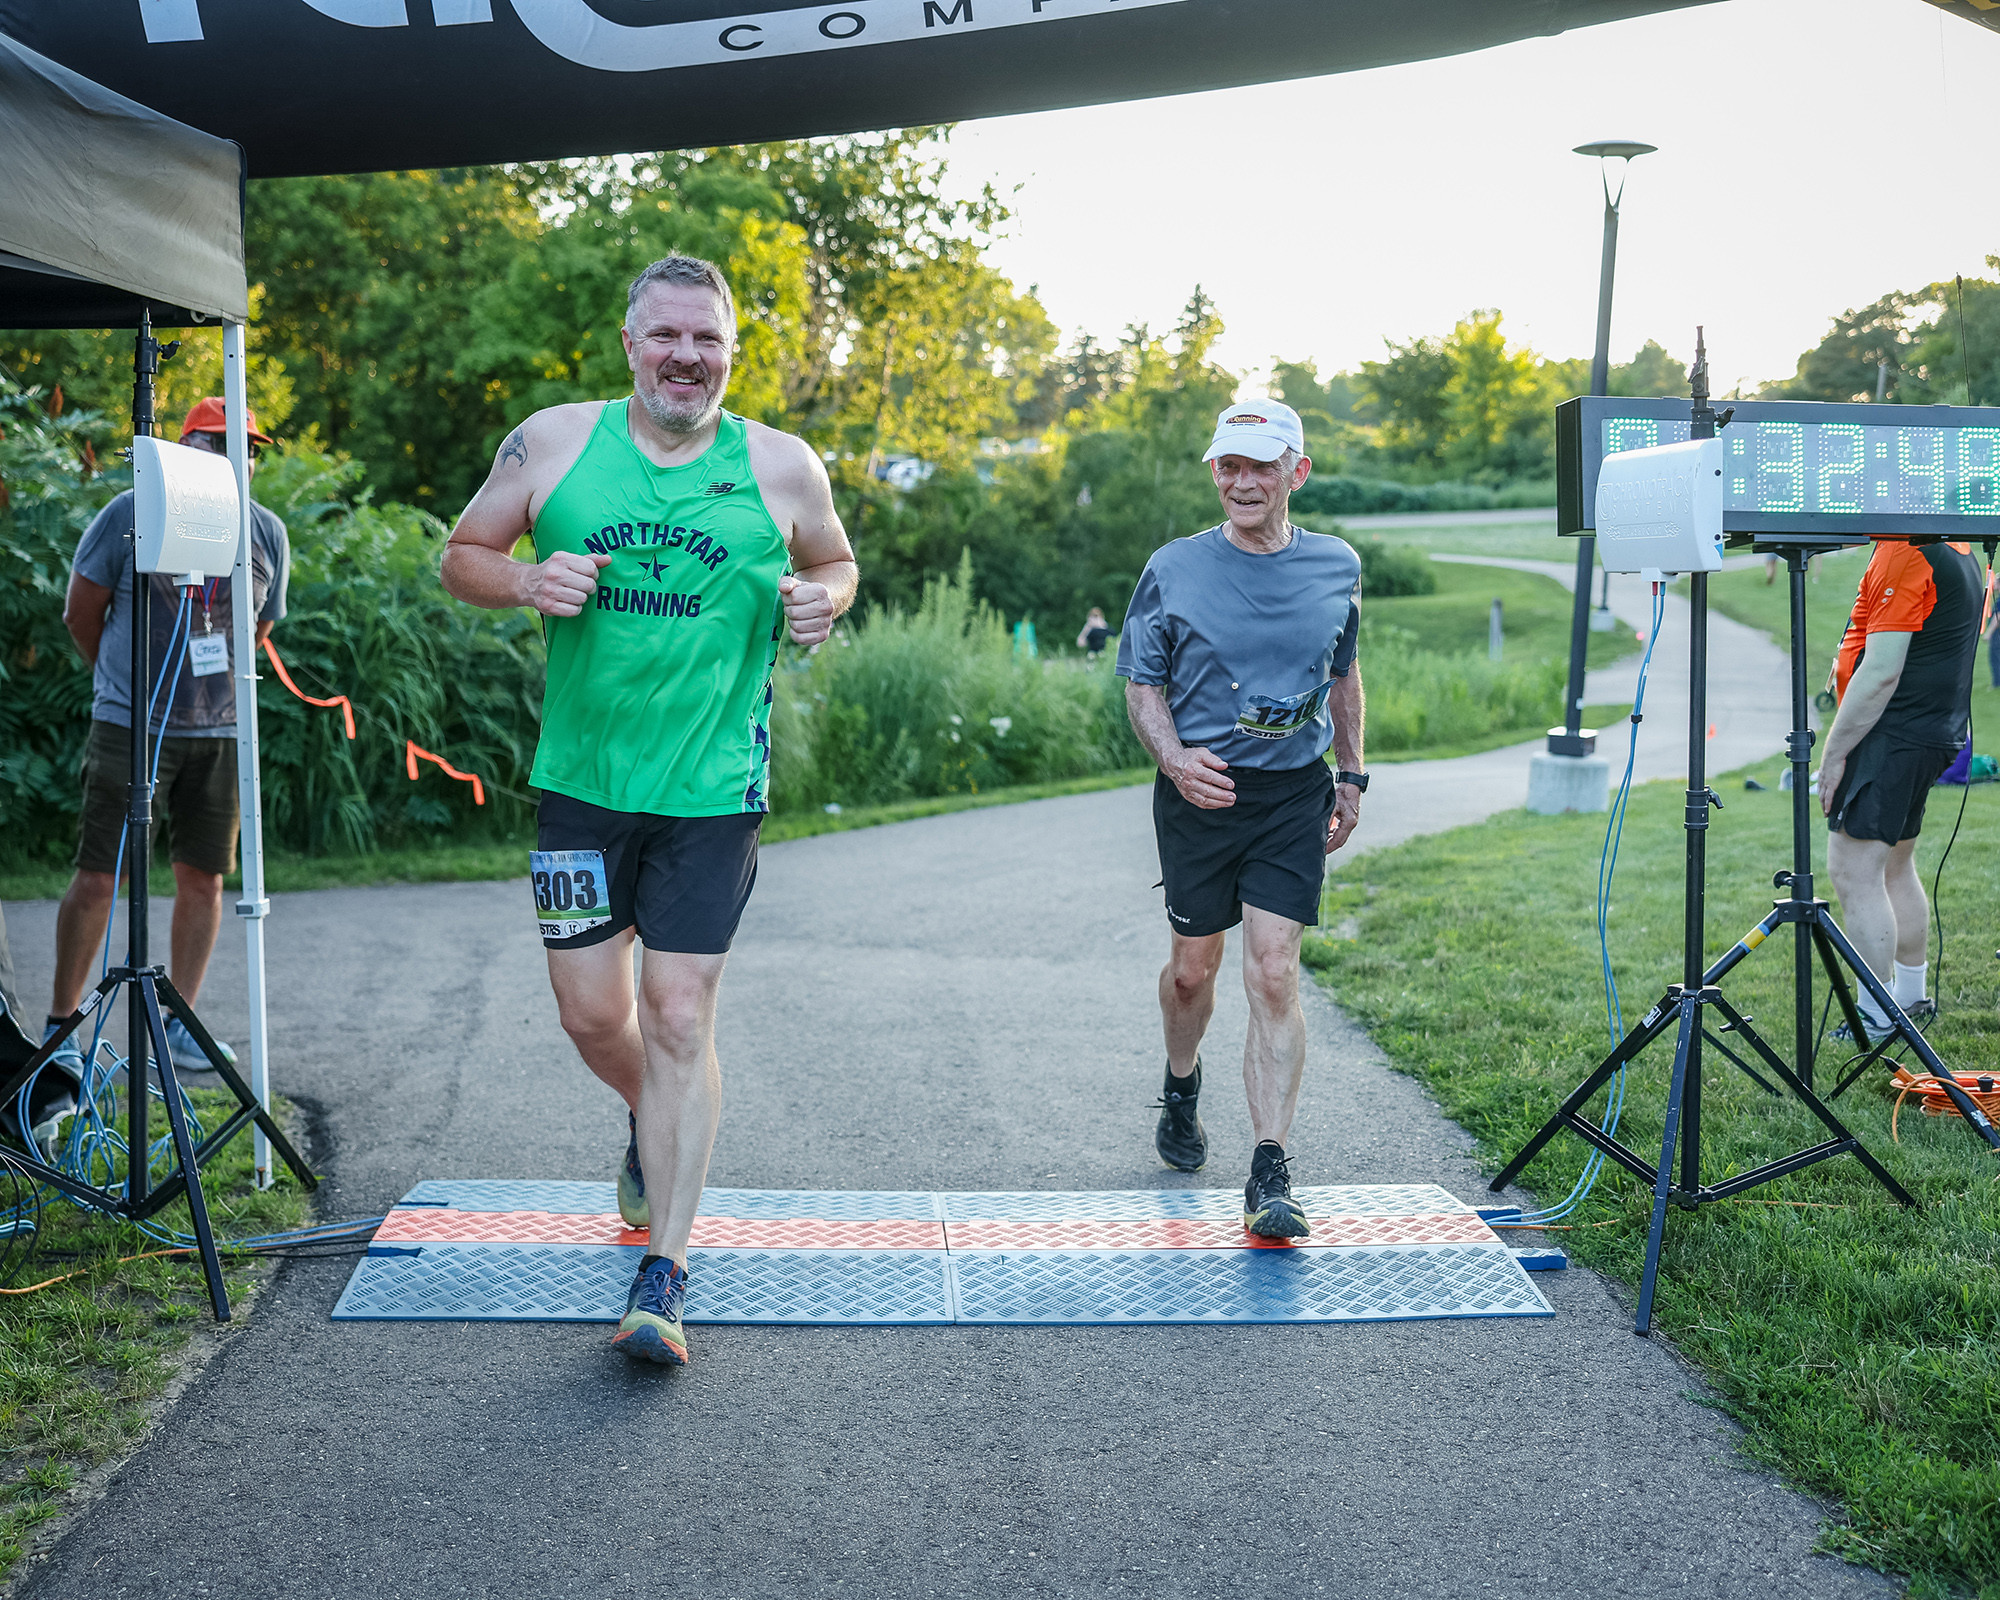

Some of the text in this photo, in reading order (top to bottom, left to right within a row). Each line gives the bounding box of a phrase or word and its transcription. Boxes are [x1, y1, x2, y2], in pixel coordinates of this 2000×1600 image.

[718, 0, 1120, 52] COM
[1608, 417, 2000, 515] :32:48
[583, 522, 729, 572] NORTHSTAR
[596, 585, 702, 618] RUNNING
